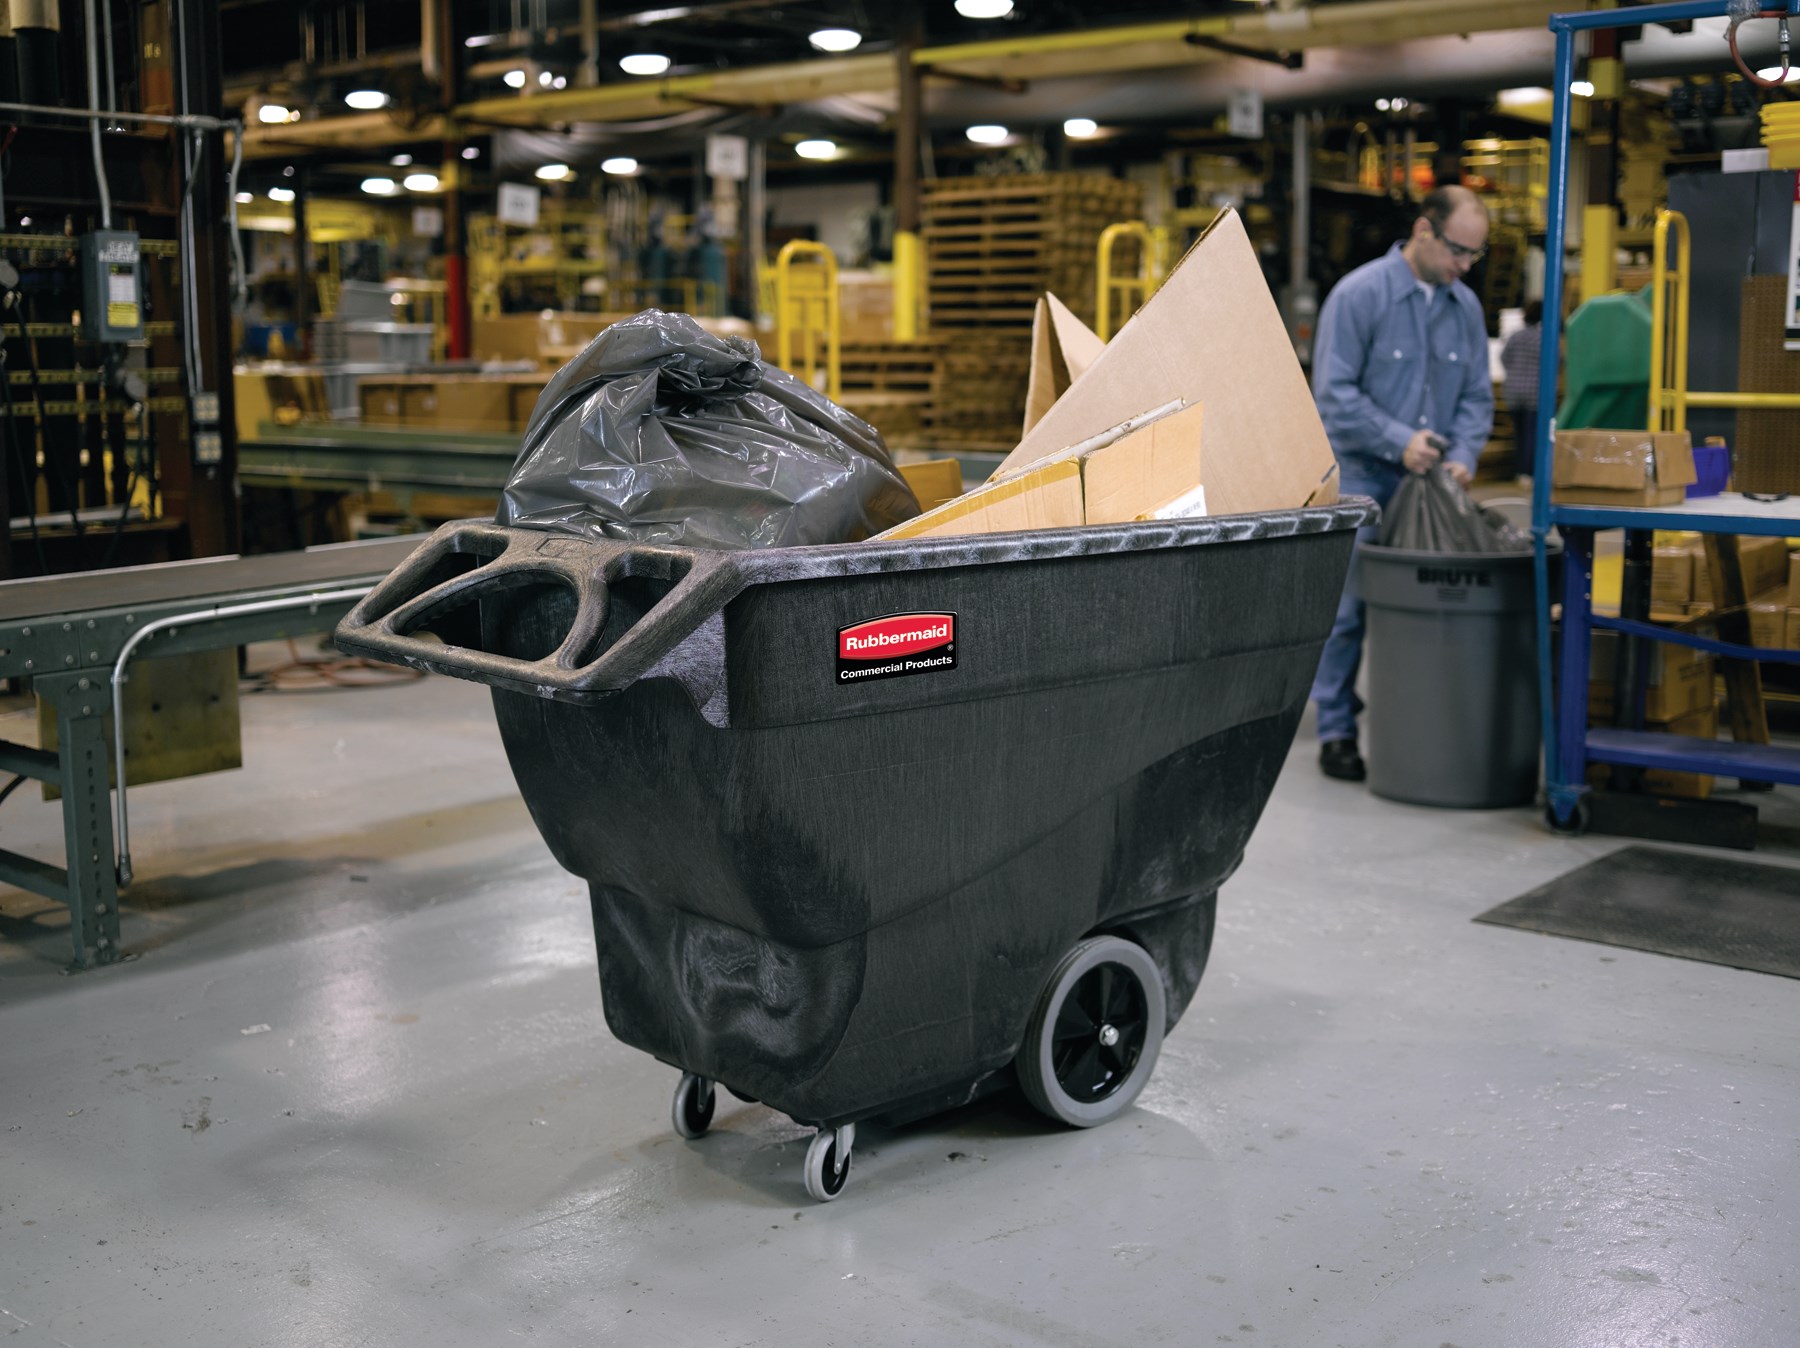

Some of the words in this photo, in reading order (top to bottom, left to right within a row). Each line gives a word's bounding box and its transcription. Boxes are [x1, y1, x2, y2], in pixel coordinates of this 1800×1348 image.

[1418, 568, 1492, 587] BRUTE
[846, 624, 947, 650] Rubbermaid
[840, 662, 903, 679] Commercial
[905, 656, 953, 670] Products
